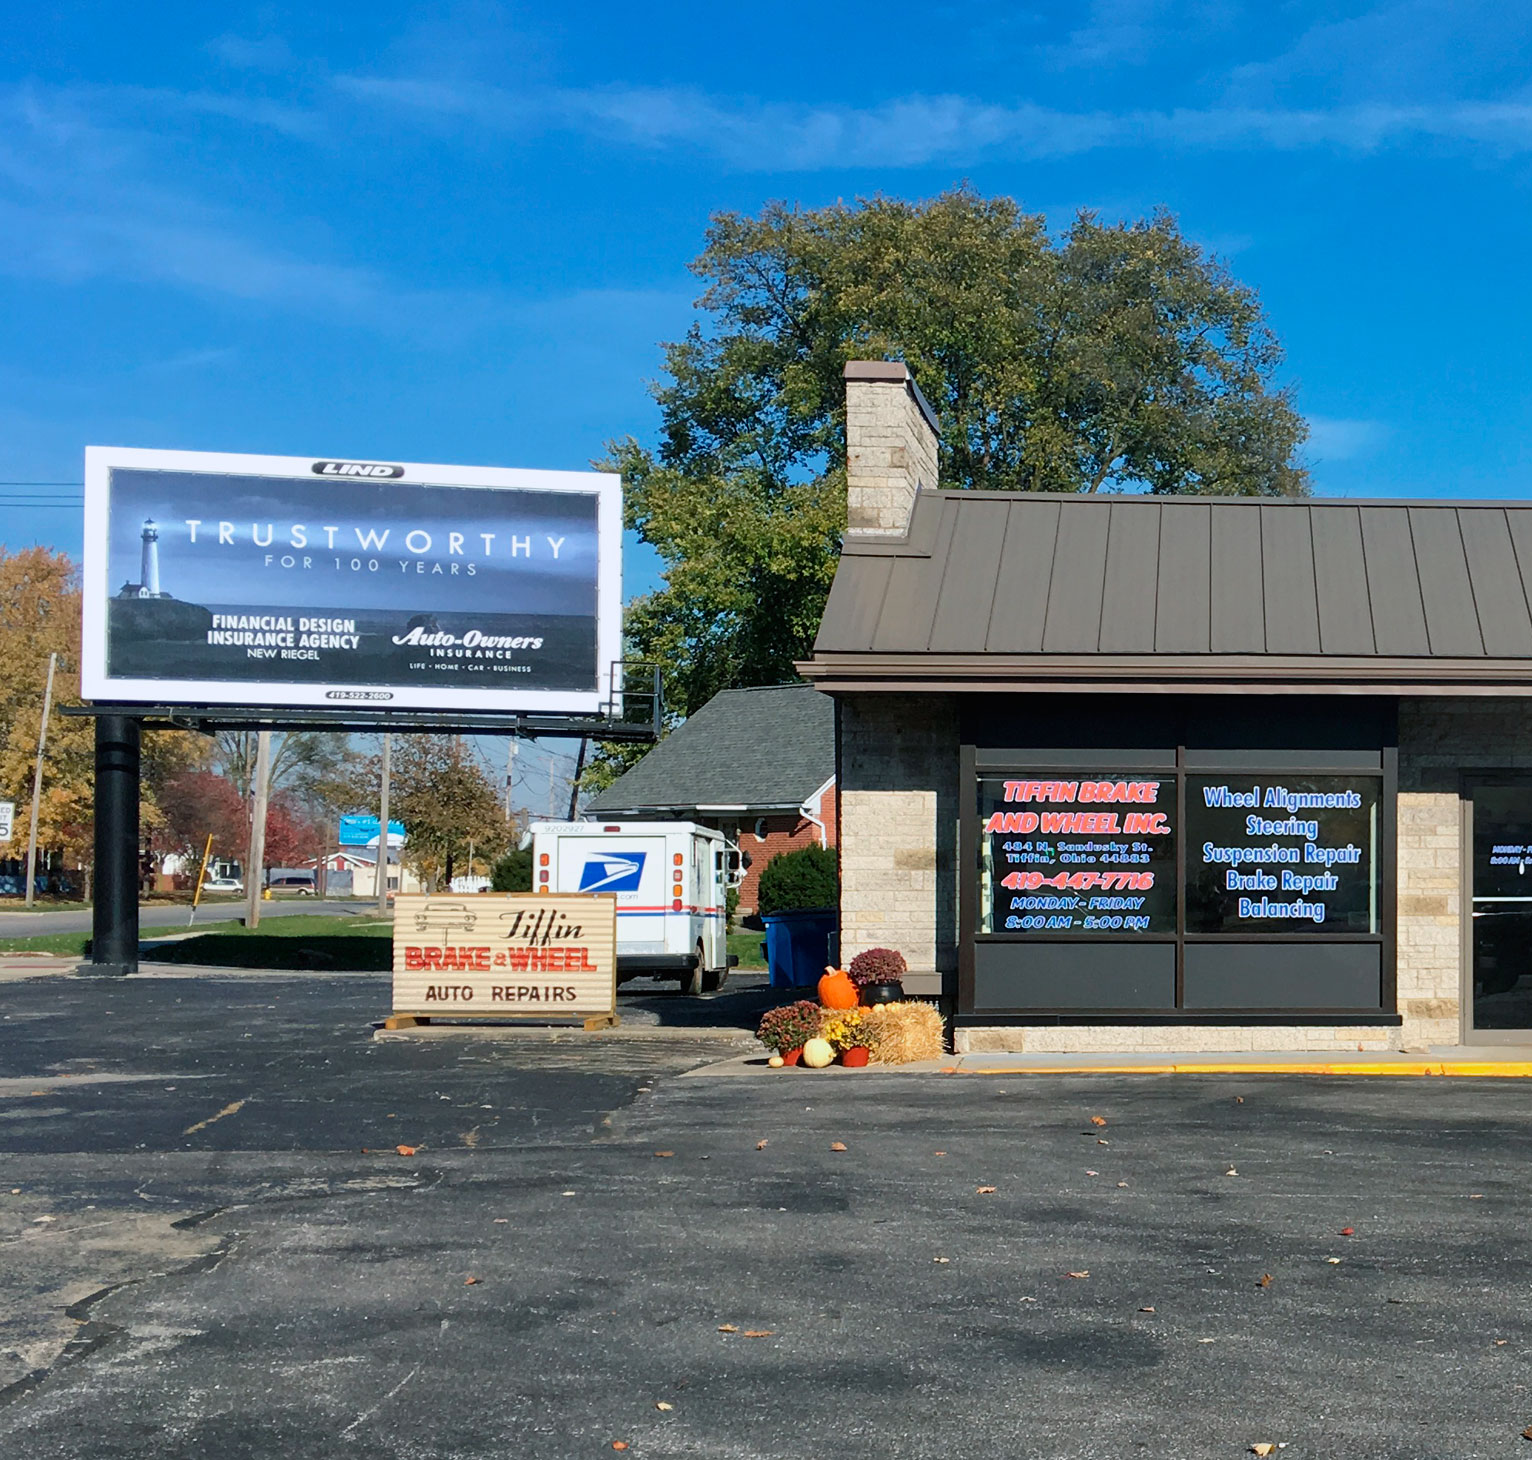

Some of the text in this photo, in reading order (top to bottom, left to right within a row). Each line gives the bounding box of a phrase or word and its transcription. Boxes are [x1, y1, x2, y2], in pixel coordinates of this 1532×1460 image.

[322, 463, 394, 477] LIND
[185, 519, 566, 560] TRUSTWORTHY
[264, 554, 477, 576] FOR 100 YEARS
[212, 614, 355, 633] FINANCIAL DESIGN
[207, 630, 360, 649] INSURANCE AGENCY
[391, 626, 544, 650] Auto-Owners
[247, 648, 320, 661] NEW RIEGEL
[430, 648, 512, 660] INSURANCE
[409, 662, 532, 673] LIFE HOME CAR BUSINESS
[328, 691, 391, 700] 419-522-2600
[1003, 781, 1160, 804] TIFFIN BRAKE
[1203, 786, 1361, 813] Wheel Alignments
[544, 825, 585, 833] 9202927
[986, 812, 1171, 834] AND WHEEL INC.
[1246, 815, 1319, 840] Steering
[1002, 841, 1154, 854] 484 N. Sandusky St.
[1203, 842, 1362, 868] Suspension Repair
[1006, 853, 1151, 865] Tiffin, Ohio 44883
[1001, 872, 1154, 890] 419-447-7716
[1226, 869, 1339, 895] Brake Repair
[1010, 896, 1079, 909] MONDAY
[1088, 896, 1145, 909] FRIDAY
[1239, 896, 1325, 923] Balancing
[499, 908, 585, 947] Tiffin
[1005, 915, 1046, 928] 8:00
[1046, 915, 1073, 928] AM
[1083, 915, 1123, 928] 5:00
[1124, 915, 1150, 928] PM
[405, 946, 598, 972] BRAKE & WHEEL
[425, 985, 577, 1002] AUTO REPAIRS
